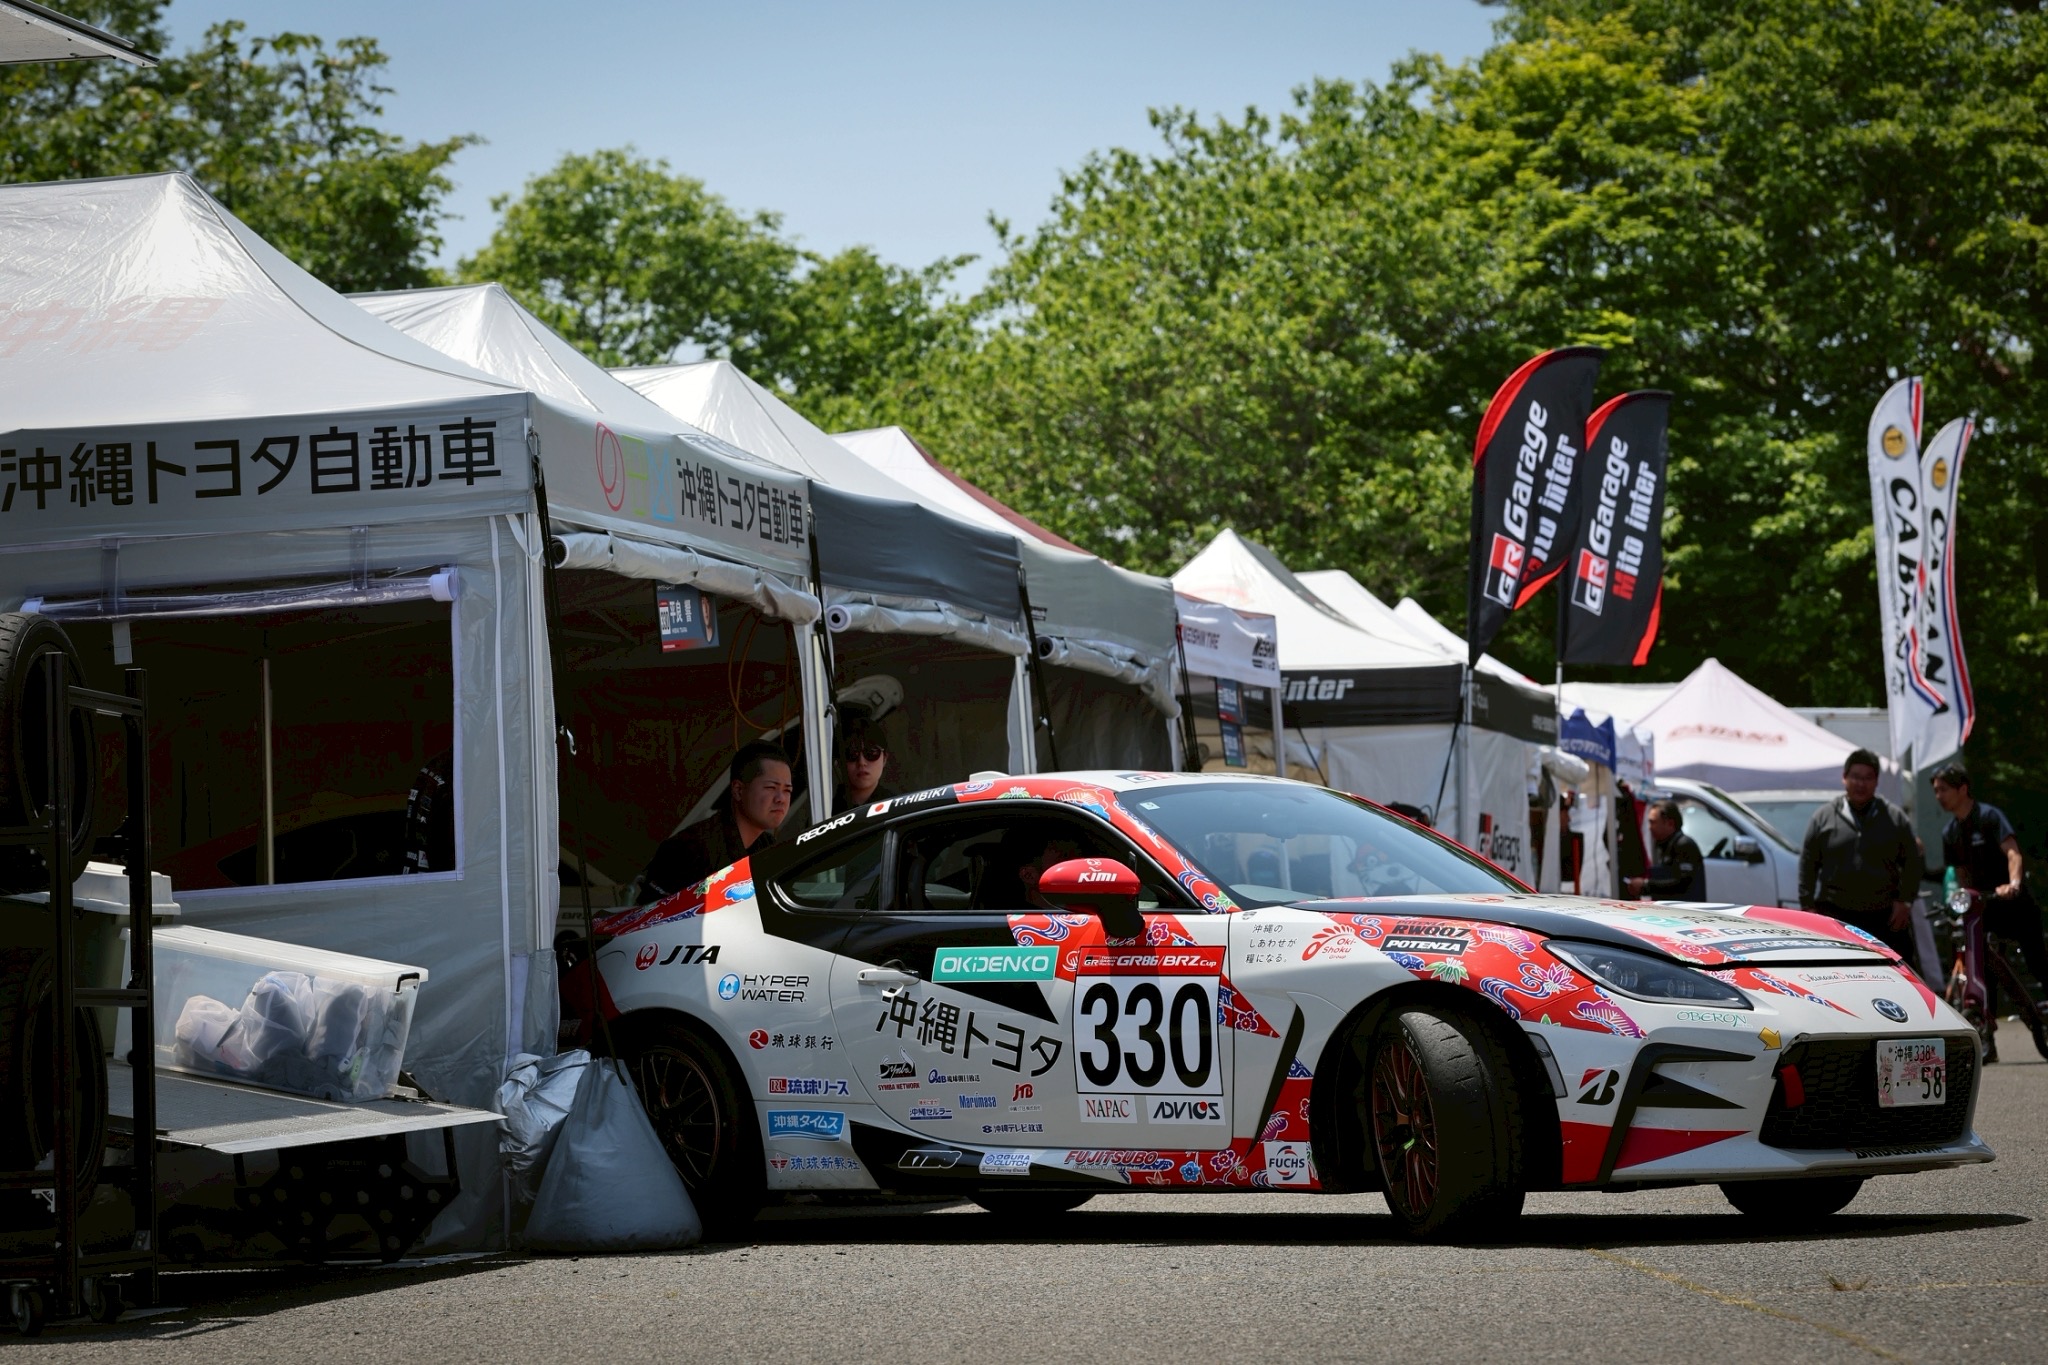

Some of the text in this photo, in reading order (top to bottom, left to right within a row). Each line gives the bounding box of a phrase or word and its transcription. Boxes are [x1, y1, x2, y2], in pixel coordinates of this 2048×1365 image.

[0, 417, 501, 512] 沖縄トヨタ自動車
[1538, 433, 1577, 514] inter
[675, 458, 805, 548] 沖縄トヨタ自動車
[1498, 400, 1549, 604] GR Garage
[1584, 436, 1631, 614] GR Garage
[1612, 461, 1658, 600] Mito inter
[894, 787, 947, 807] T.HIBIKI
[796, 812, 856, 846] RECARO
[1252, 924, 1283, 934] 沖縄の
[1249, 938, 1297, 948] しあわせが
[1322, 946, 1351, 954] Shoku
[1386, 940, 1461, 951] POTENZA
[659, 945, 721, 965] JTA
[1200, 960, 1217, 968] Cup
[743, 974, 810, 987] HYPER
[741, 989, 805, 1002] WATER
[1677, 1010, 1747, 1027] OBERON
[875, 988, 1063, 1077] 沖縄トヨタ
[1080, 983, 1213, 1088] 330
[772, 1034, 834, 1050] 琉球銀行
[1894, 1045, 1931, 1062] 沖縄 338
[787, 1079, 849, 1095] 琉球リース
[896, 1082, 920, 1090] NETWORK
[1012, 1083, 1033, 1101] JTB
[1883, 1076, 1892, 1093] ろ
[1086, 1099, 1221, 1120] NAPAC ADVICS
[774, 1115, 838, 1129] 沖縄タイムス
[994, 1124, 1043, 1132] 沖縄テレビ放送
[790, 1156, 860, 1170] 琉球新報社
[1064, 1150, 1159, 1165] FUJITSUBO
[1269, 1157, 1305, 1168] FUCHS
